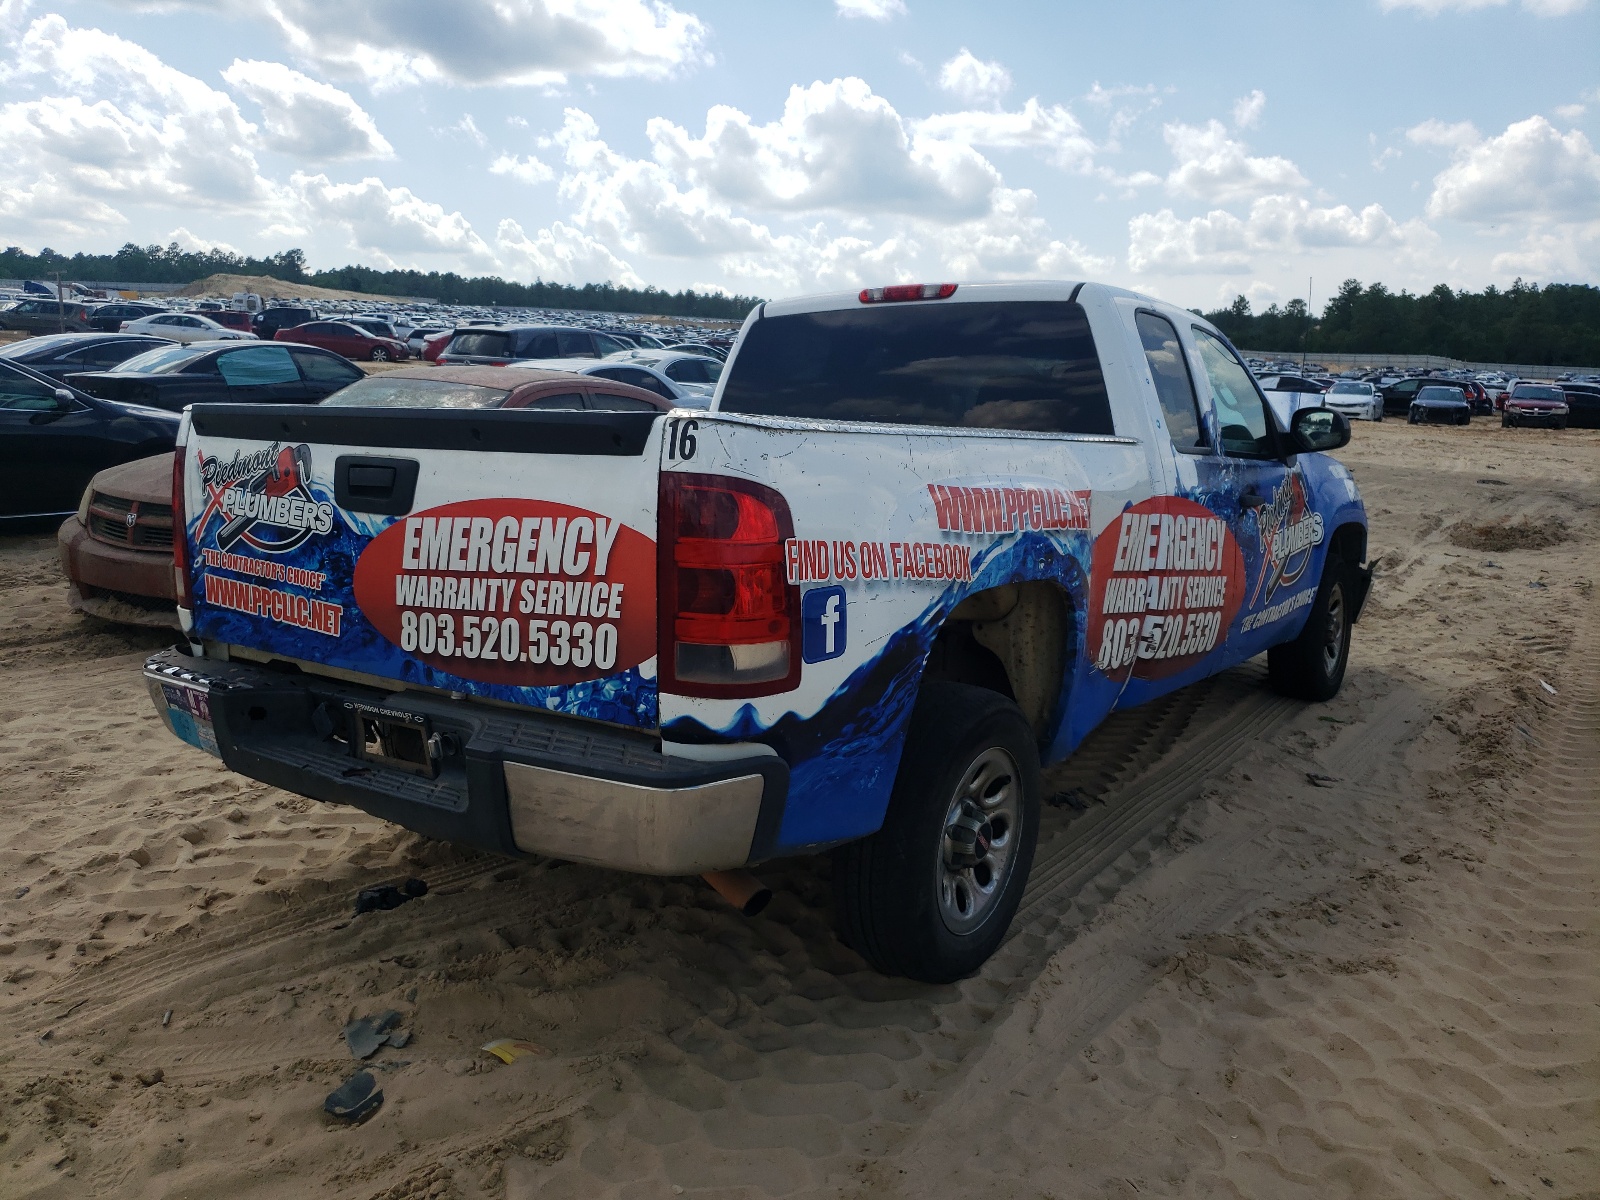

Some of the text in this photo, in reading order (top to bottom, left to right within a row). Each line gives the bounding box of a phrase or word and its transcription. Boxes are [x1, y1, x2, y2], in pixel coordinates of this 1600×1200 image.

[668, 420, 699, 461] 16
[201, 442, 281, 496] Piedmont
[222, 487, 333, 534] PLUMBERS
[402, 516, 621, 576] EMERGENCY
[785, 538, 972, 584] FIND US ON FACEBOOK
[1113, 512, 1227, 572] EMERGENCY
[1271, 512, 1324, 563] PLUMBERS
[220, 553, 285, 582] CONTRACTOR'S
[205, 574, 343, 638] WWW.PPCLLC.NET
[396, 575, 625, 618] WARRANTY SERVICE
[1103, 575, 1227, 615] WARRANTY SERVICE
[401, 611, 618, 670] 803.520.5330
